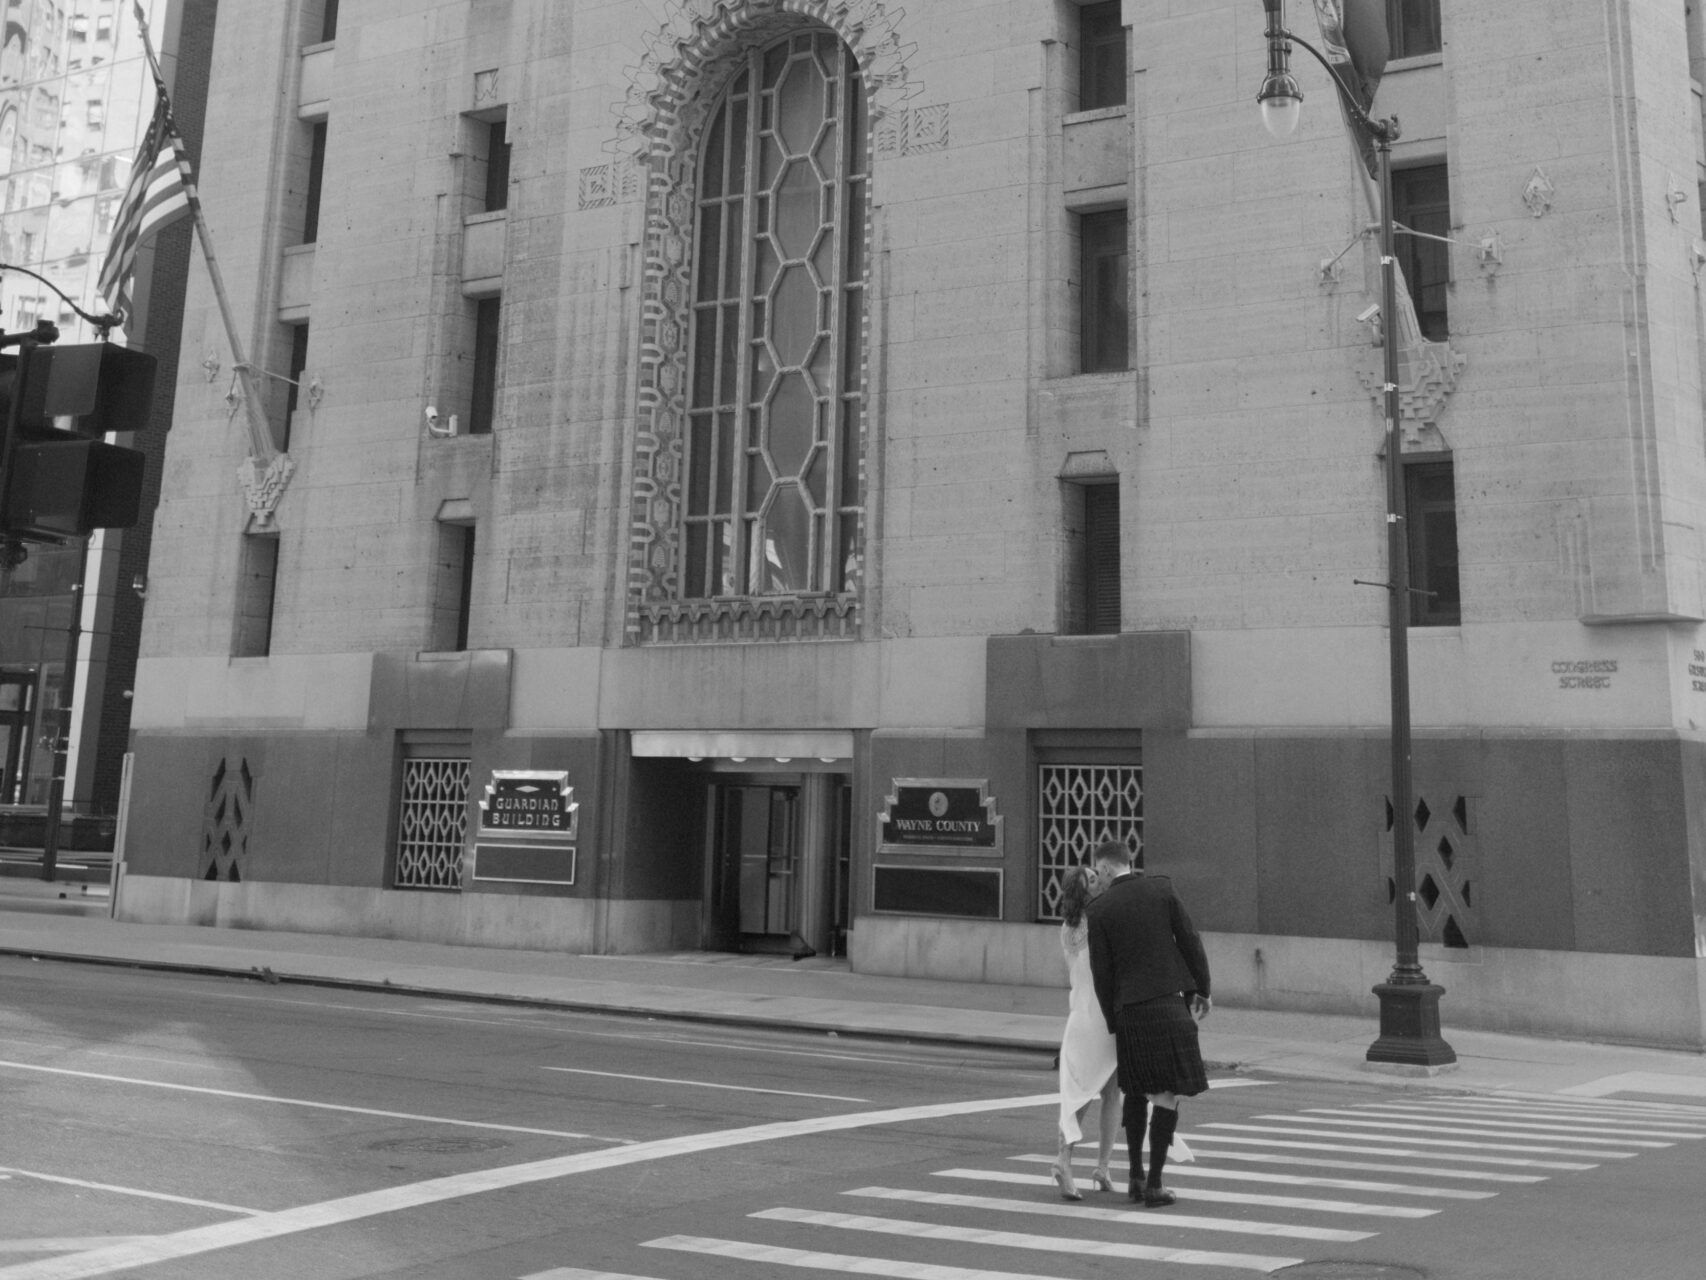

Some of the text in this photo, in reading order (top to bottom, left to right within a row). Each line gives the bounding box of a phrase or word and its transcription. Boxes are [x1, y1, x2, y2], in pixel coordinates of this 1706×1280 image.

[1552, 660, 1618, 673] CONGRESS
[1559, 676, 1611, 688] STREET
[496, 798, 558, 810] GUARDIAN
[492, 813, 560, 826] BUILDING
[896, 819, 981, 832] WAYNE COUNTY
